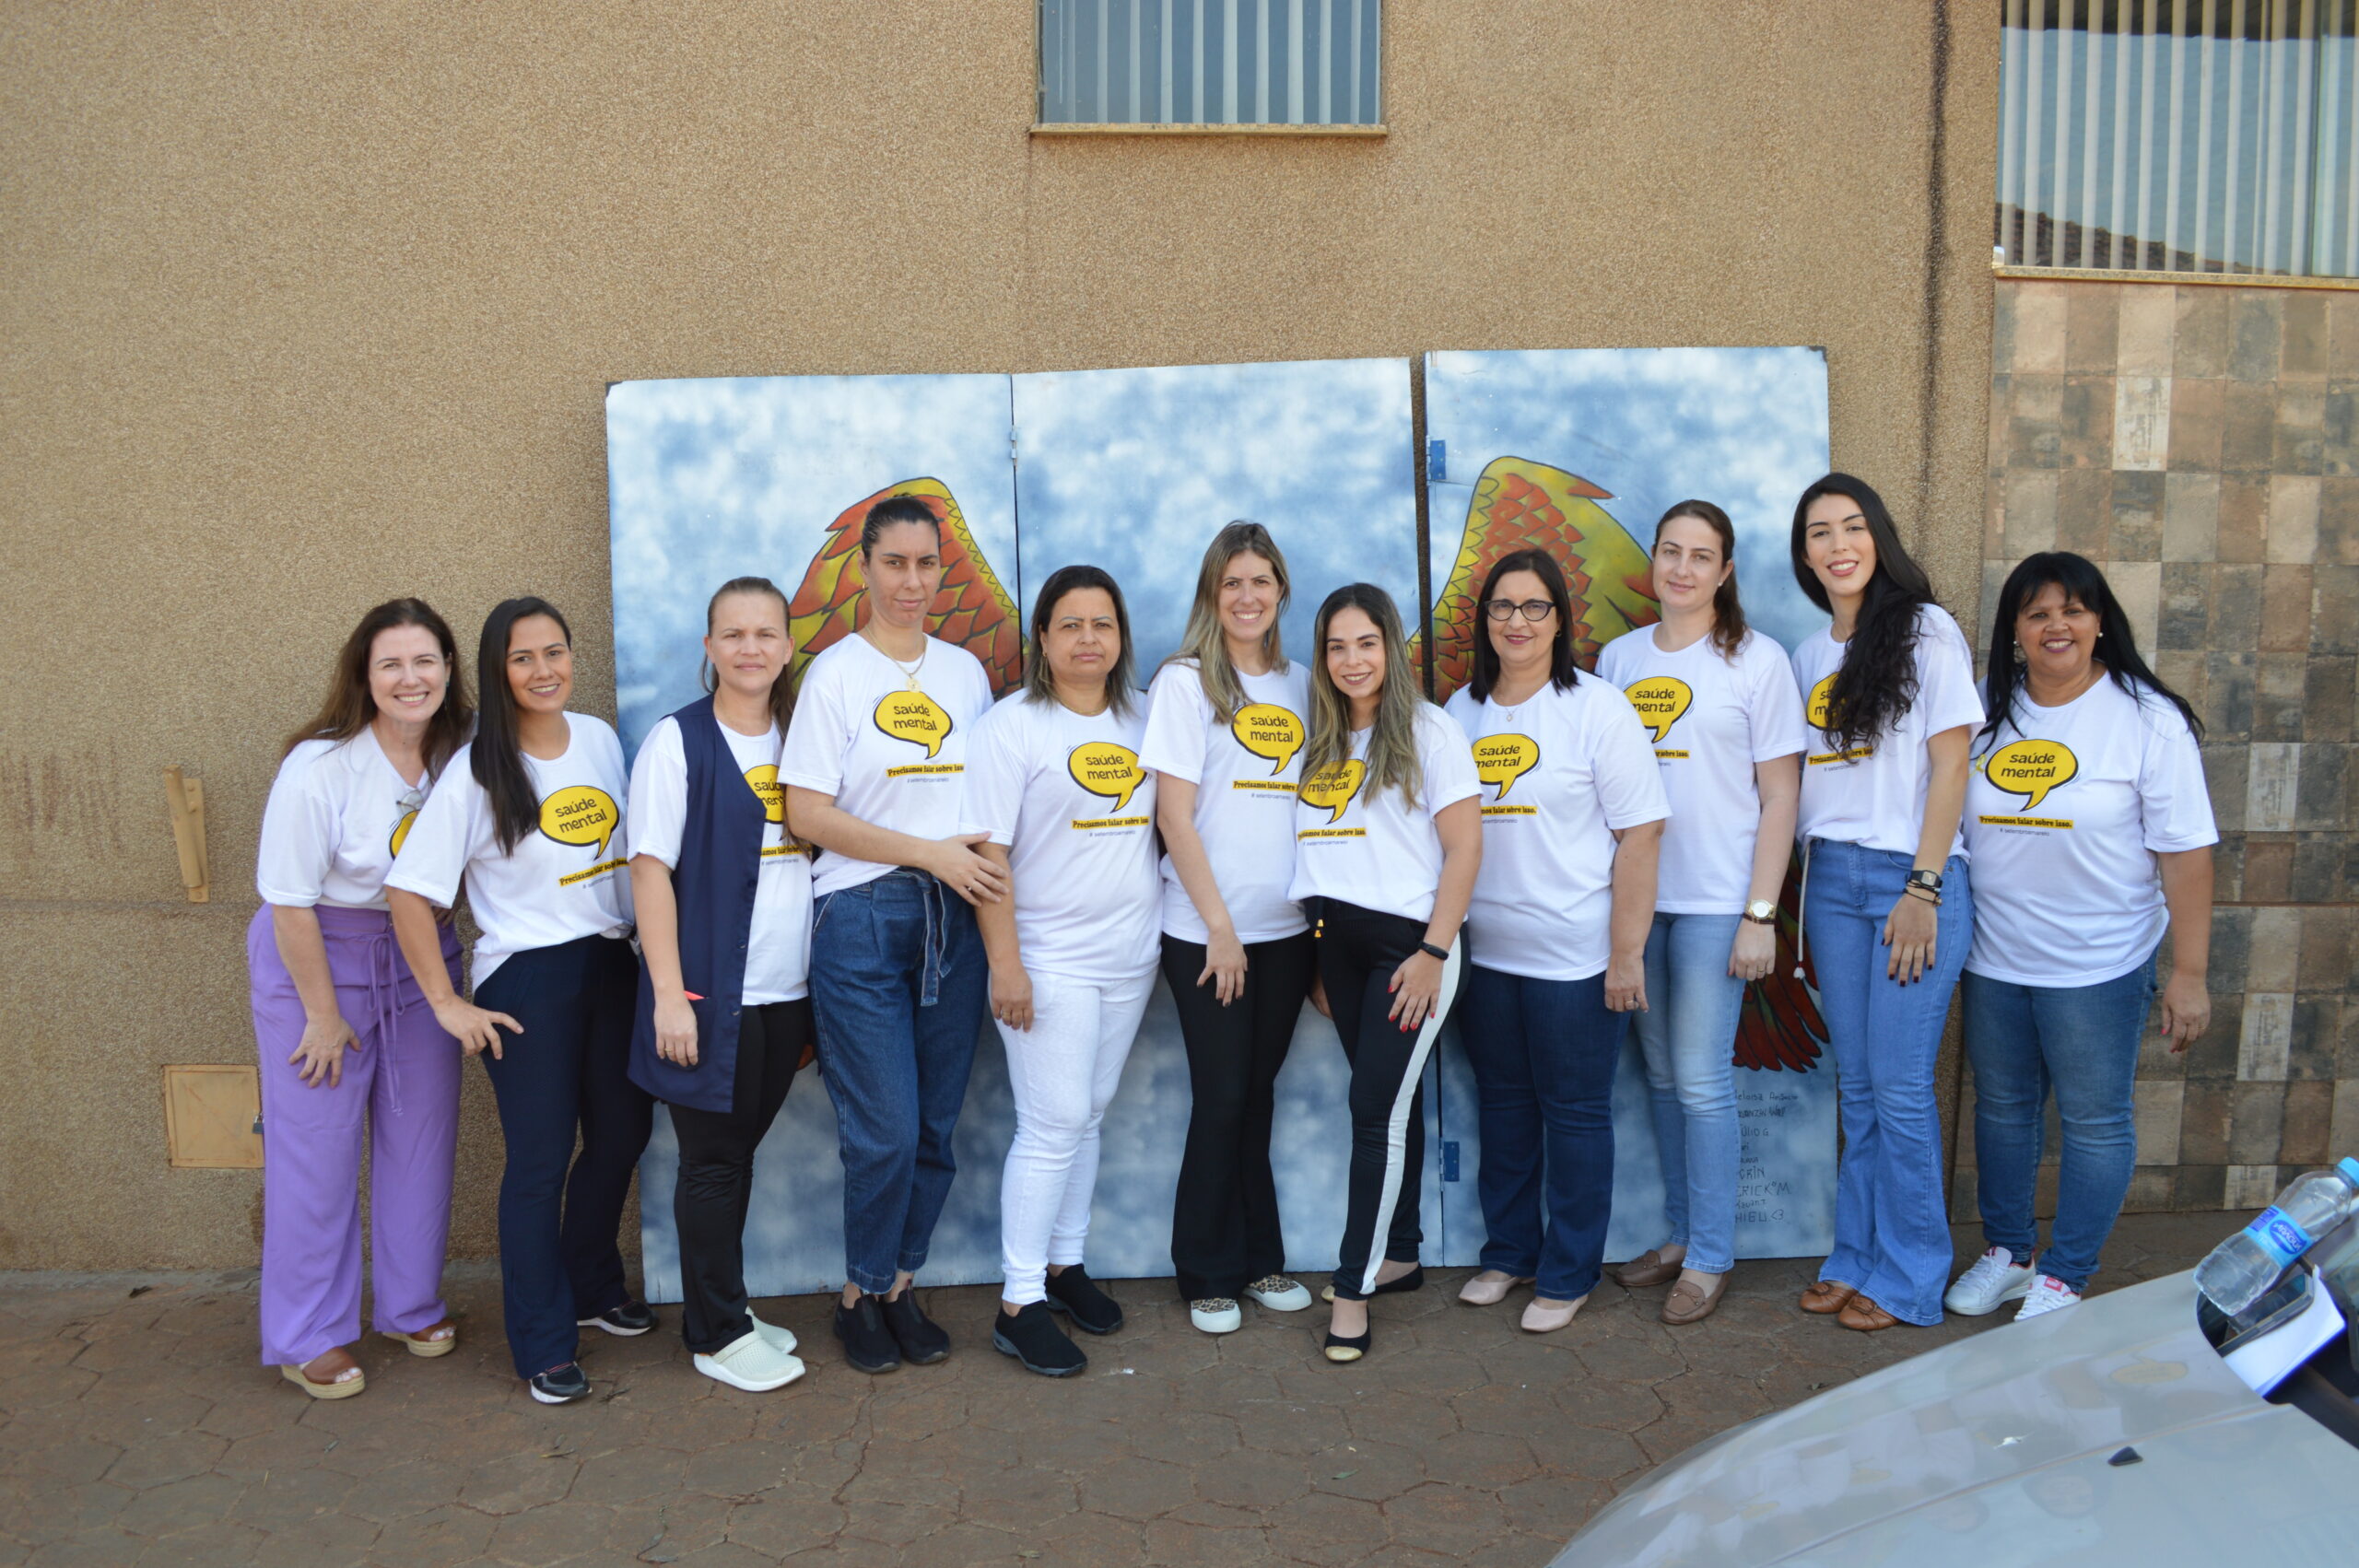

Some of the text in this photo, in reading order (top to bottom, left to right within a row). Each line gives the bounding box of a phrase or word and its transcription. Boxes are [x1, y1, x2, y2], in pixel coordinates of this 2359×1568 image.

[1635, 688, 1675, 699] saúde
[893, 703, 931, 716] saúde
[893, 719, 937, 731] mental
[1250, 715, 1289, 727] saúde
[1250, 731, 1294, 743] mental
[1479, 744, 1520, 756] saúde
[1086, 755, 1124, 766] saúde
[2009, 753, 2056, 764] saúde
[1086, 766, 1133, 779] mental
[2001, 766, 2056, 778] mental
[1234, 780, 1266, 789] Precisamos
[555, 798, 597, 817] saúde
[559, 809, 607, 833] mental
[1073, 819, 1107, 828] Precisamos
[1979, 816, 2016, 825] Precisamos
[2017, 816, 2033, 825] falar
[2035, 818, 2054, 826] sobre
